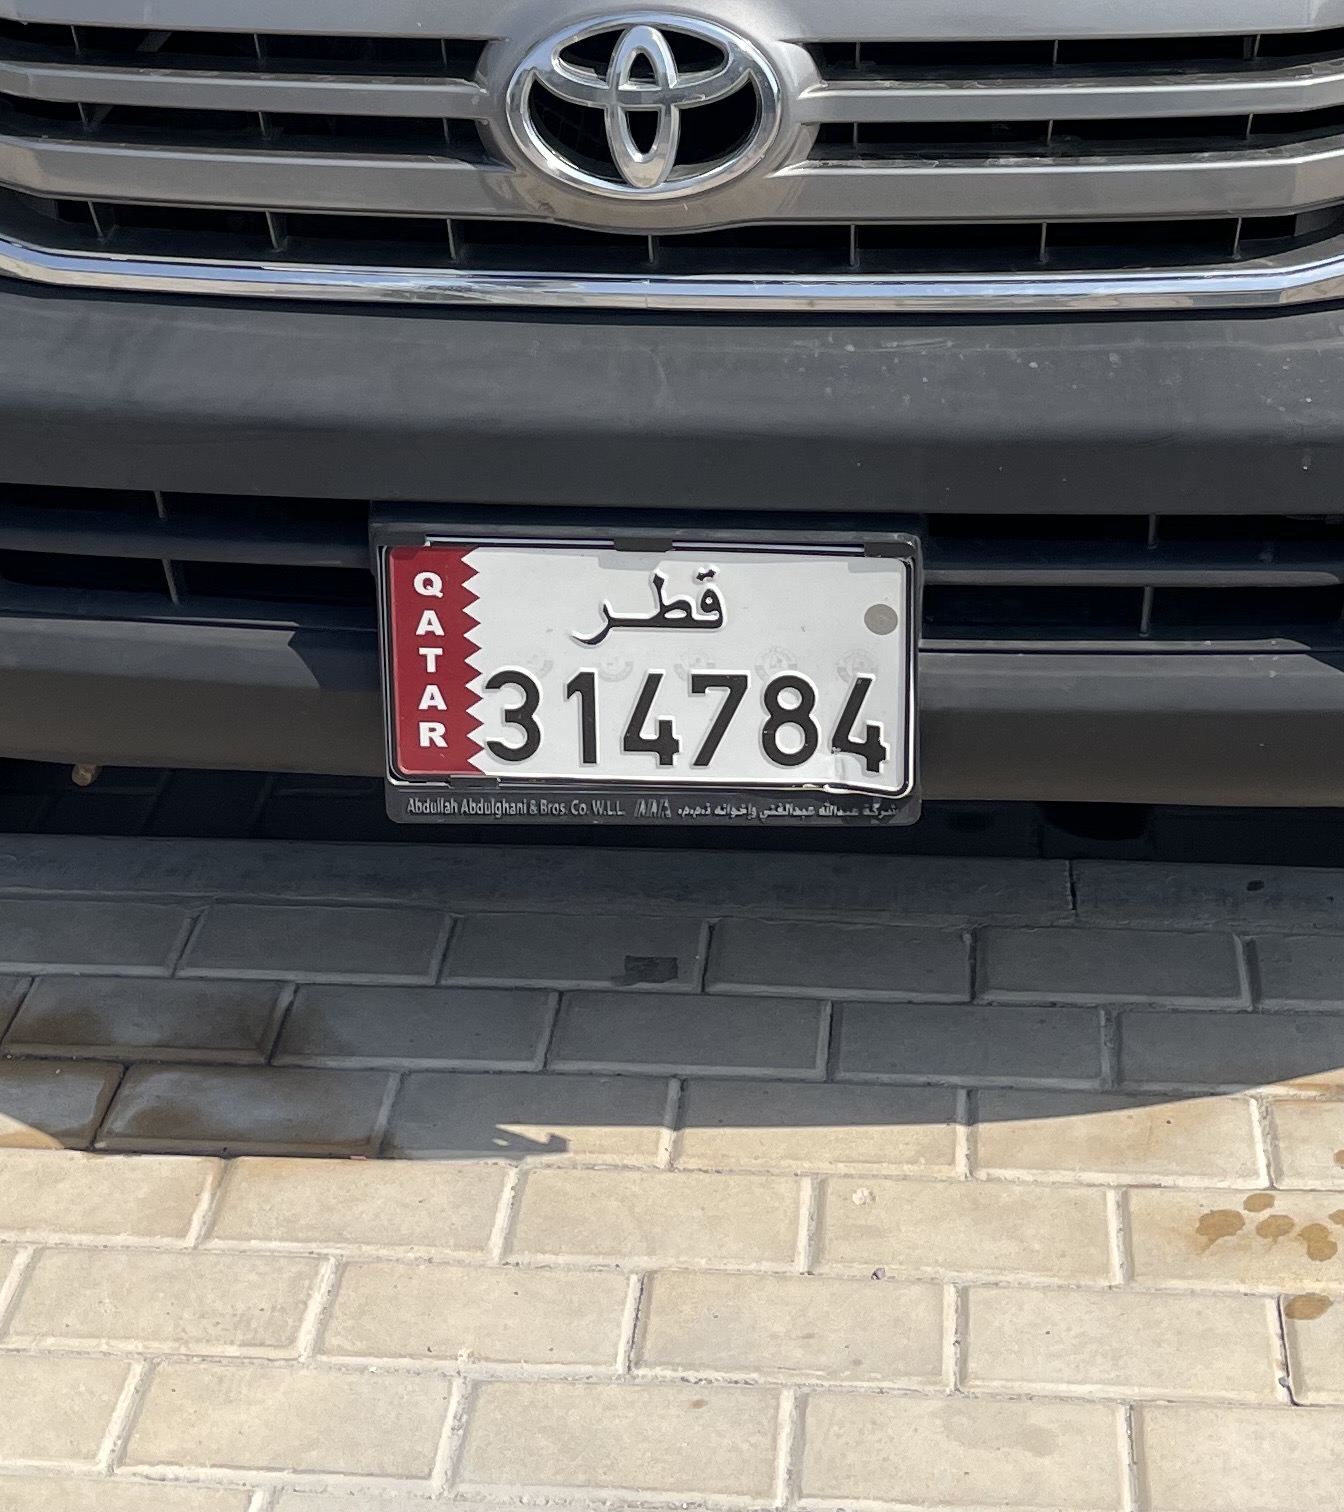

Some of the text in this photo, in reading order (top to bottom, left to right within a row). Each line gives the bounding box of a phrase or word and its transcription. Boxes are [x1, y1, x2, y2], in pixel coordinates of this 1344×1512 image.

[570, 567, 728, 647] قطر
[412, 570, 449, 749] QATAR
[482, 666, 890, 774] 314784
[407, 796, 458, 815] Abdullah
[460, 797, 527, 819] Abdulghani
[529, 799, 538, 815] &
[540, 798, 568, 815] Bros.
[570, 798, 590, 816] Co.
